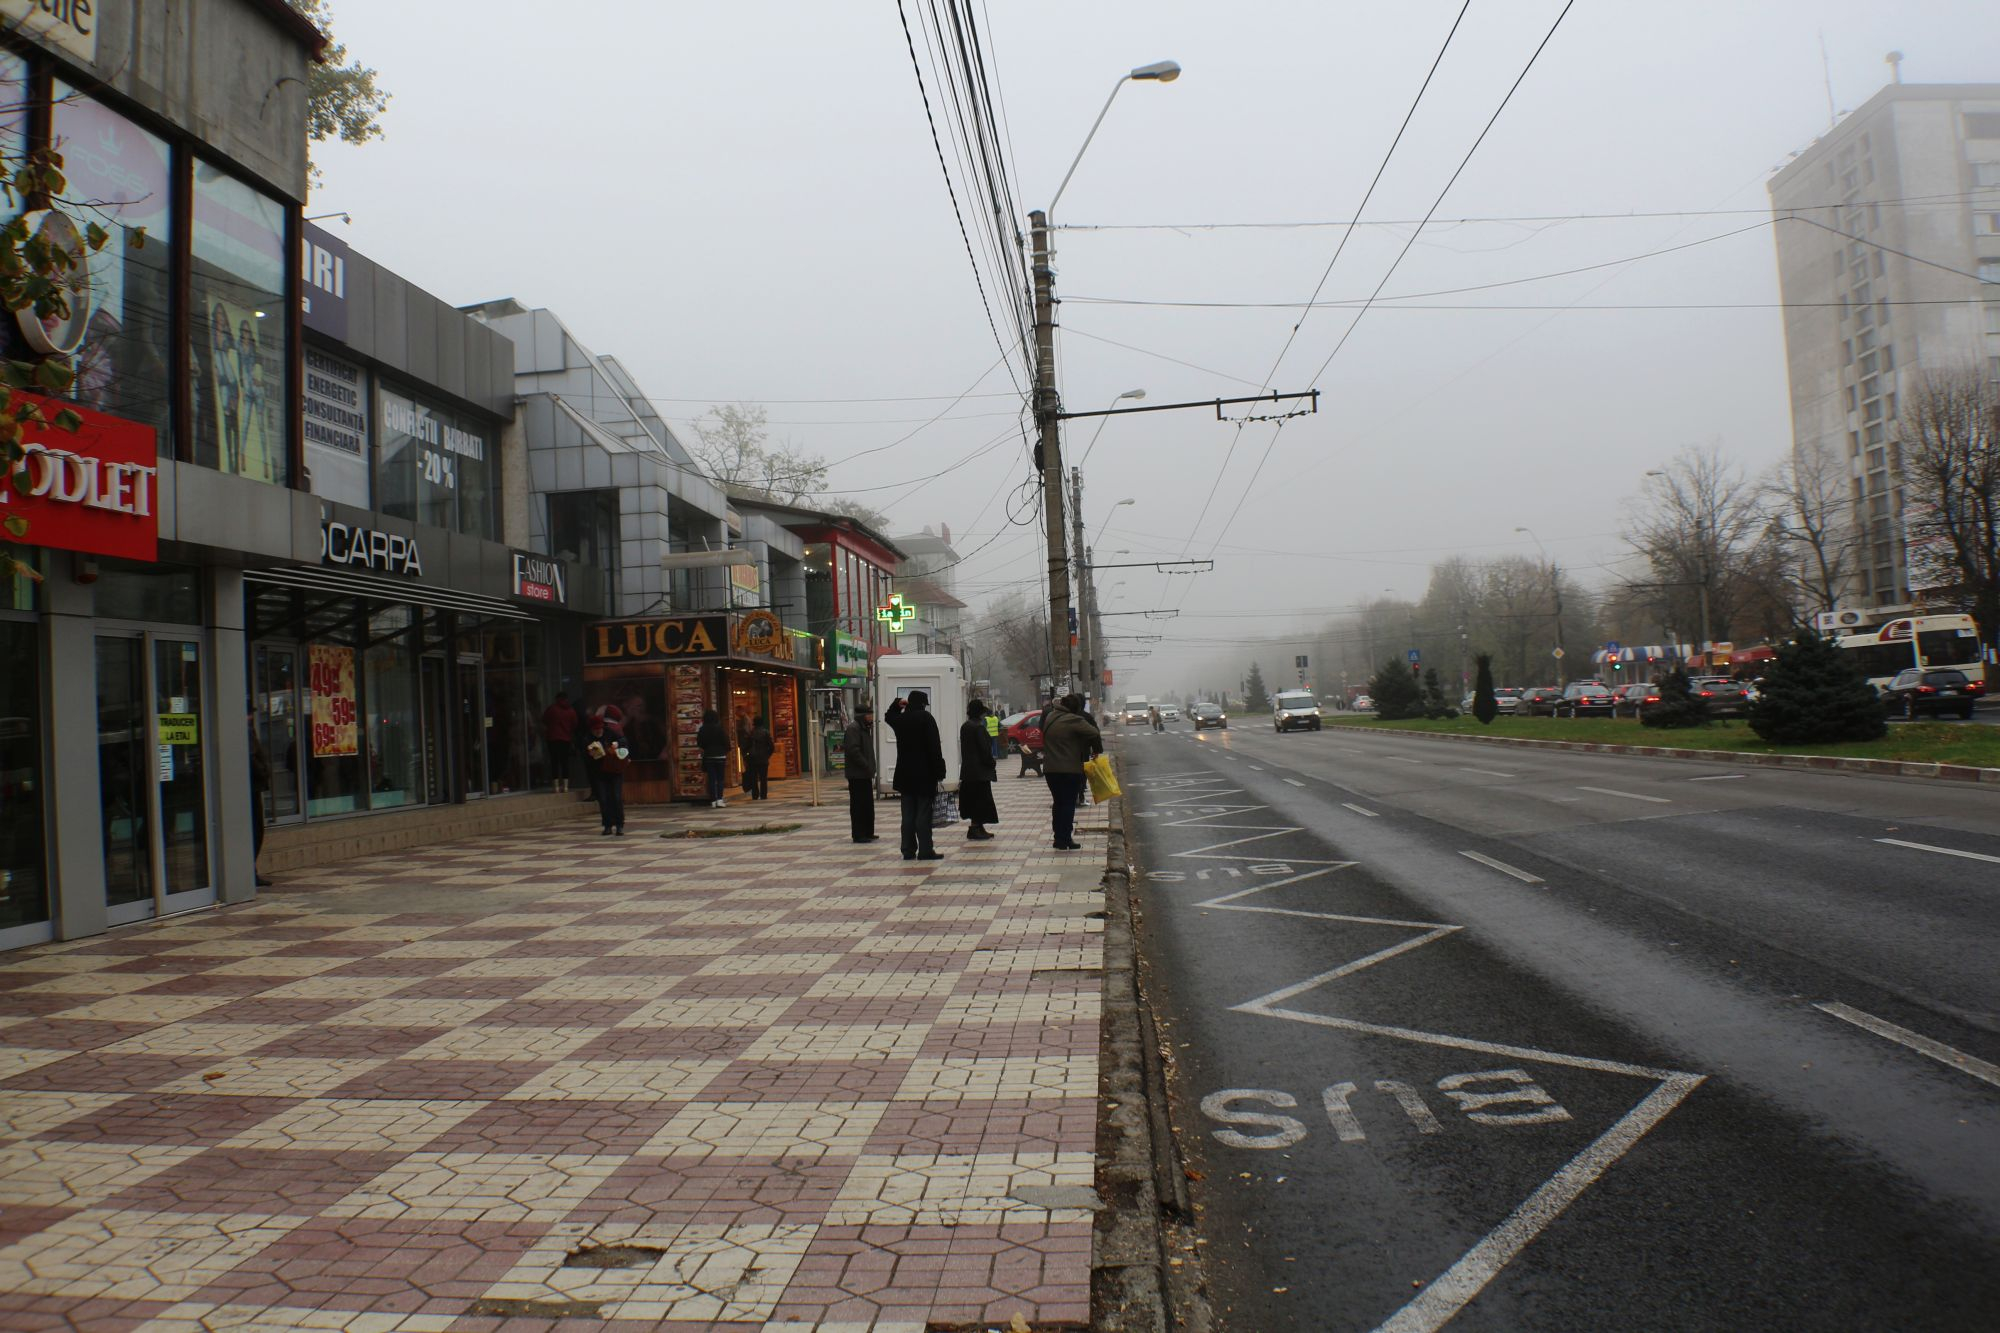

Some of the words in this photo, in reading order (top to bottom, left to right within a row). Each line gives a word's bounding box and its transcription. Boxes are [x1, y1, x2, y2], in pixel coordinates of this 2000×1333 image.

[308, 373, 357, 407] ENERGETIC
[0, 443, 156, 517] ODLET
[321, 521, 423, 577] CARPA
[514, 553, 566, 604] FASHION
[527, 583, 549, 599] store
[595, 620, 717, 658] LUCA
[1145, 863, 1295, 882] BUS
[1200, 1069, 1574, 1150] BUS
